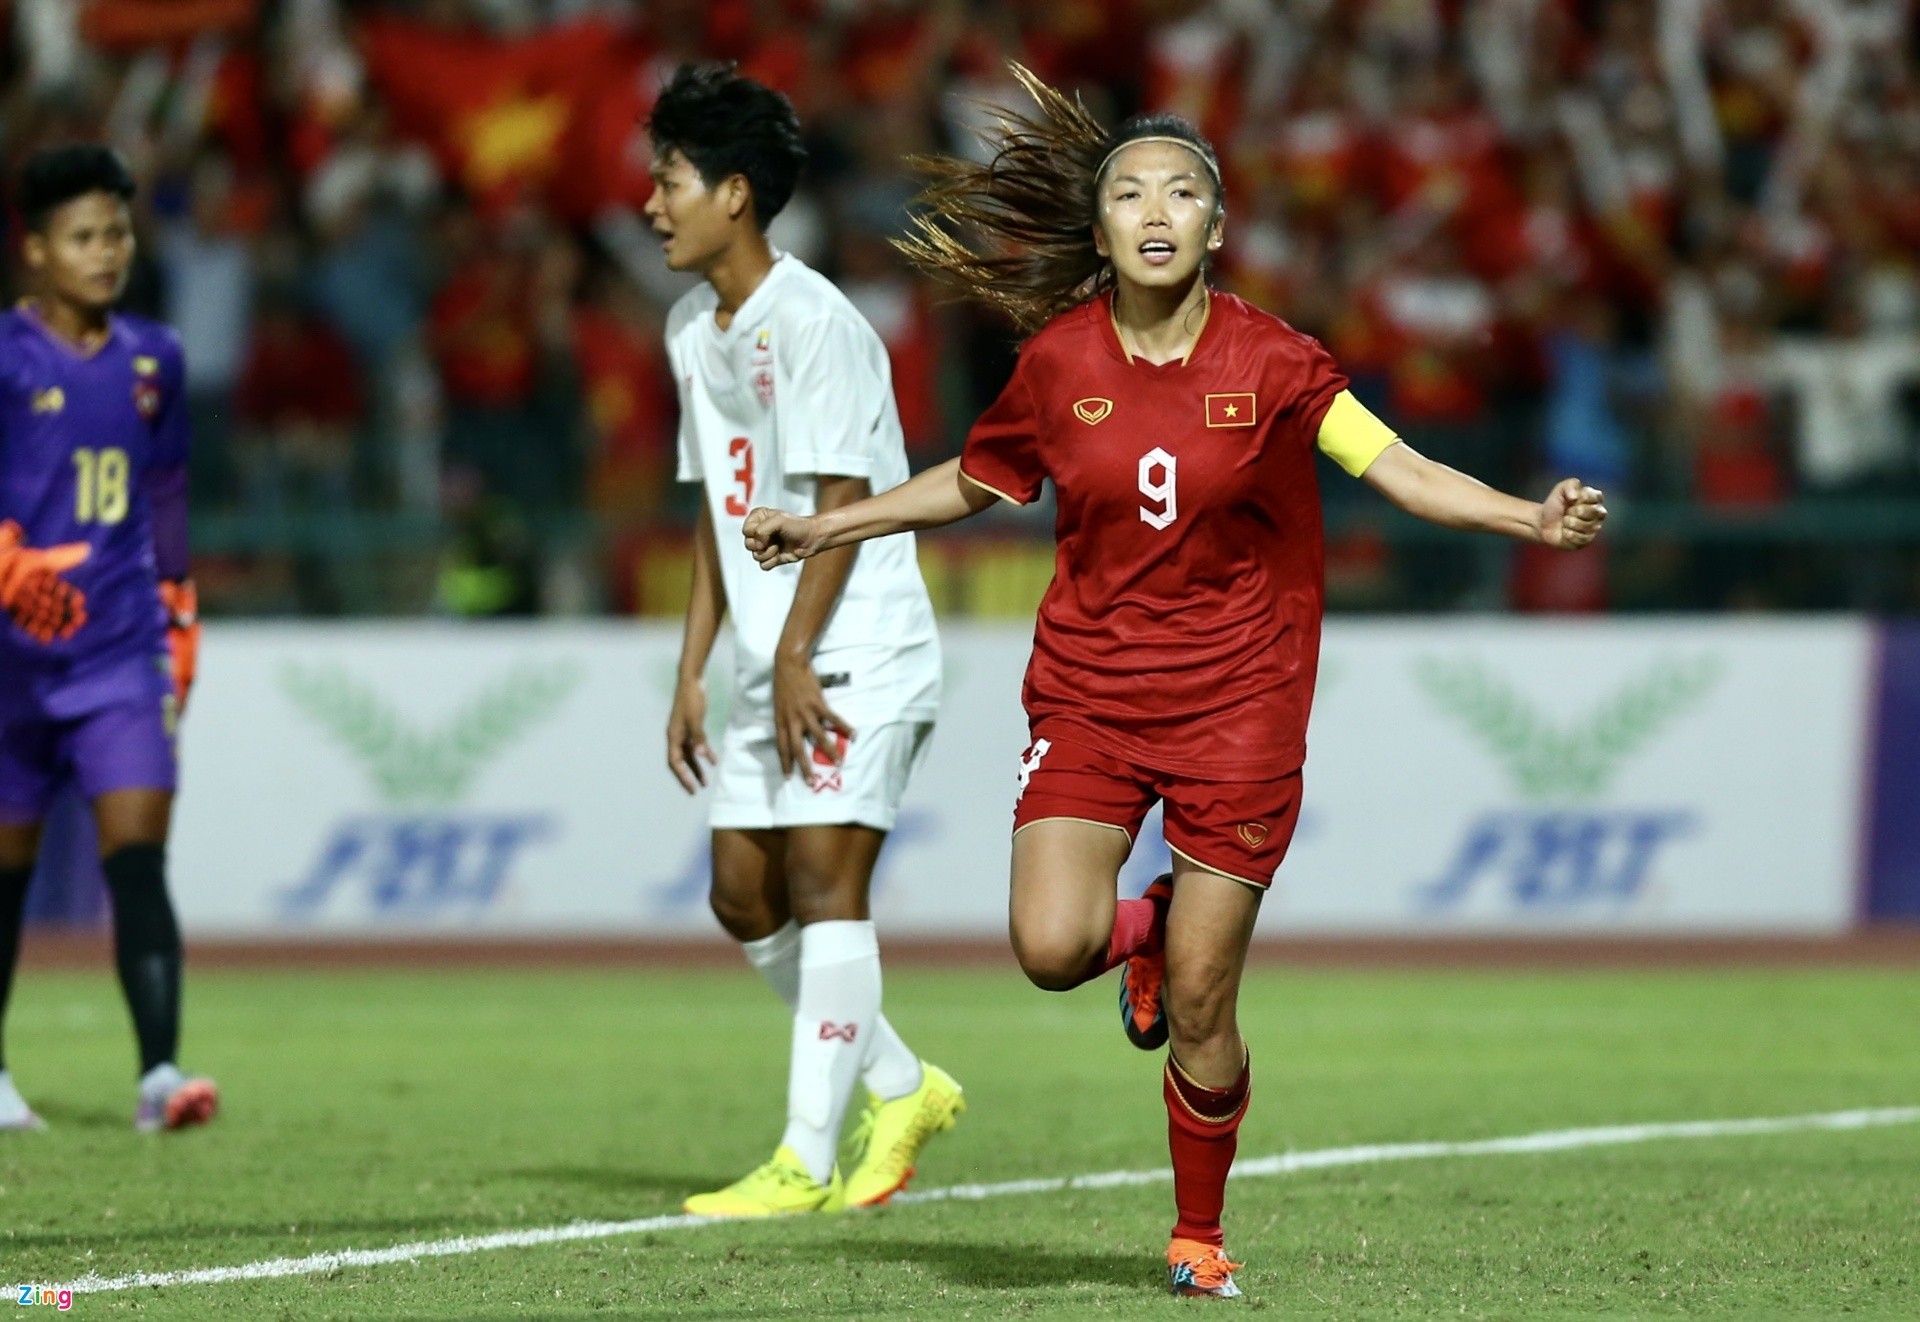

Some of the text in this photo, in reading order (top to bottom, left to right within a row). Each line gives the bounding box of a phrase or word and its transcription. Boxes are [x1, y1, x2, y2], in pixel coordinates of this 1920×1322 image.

[74, 447, 130, 525] 18
[725, 437, 754, 517] 3
[1138, 446, 1177, 531] 9
